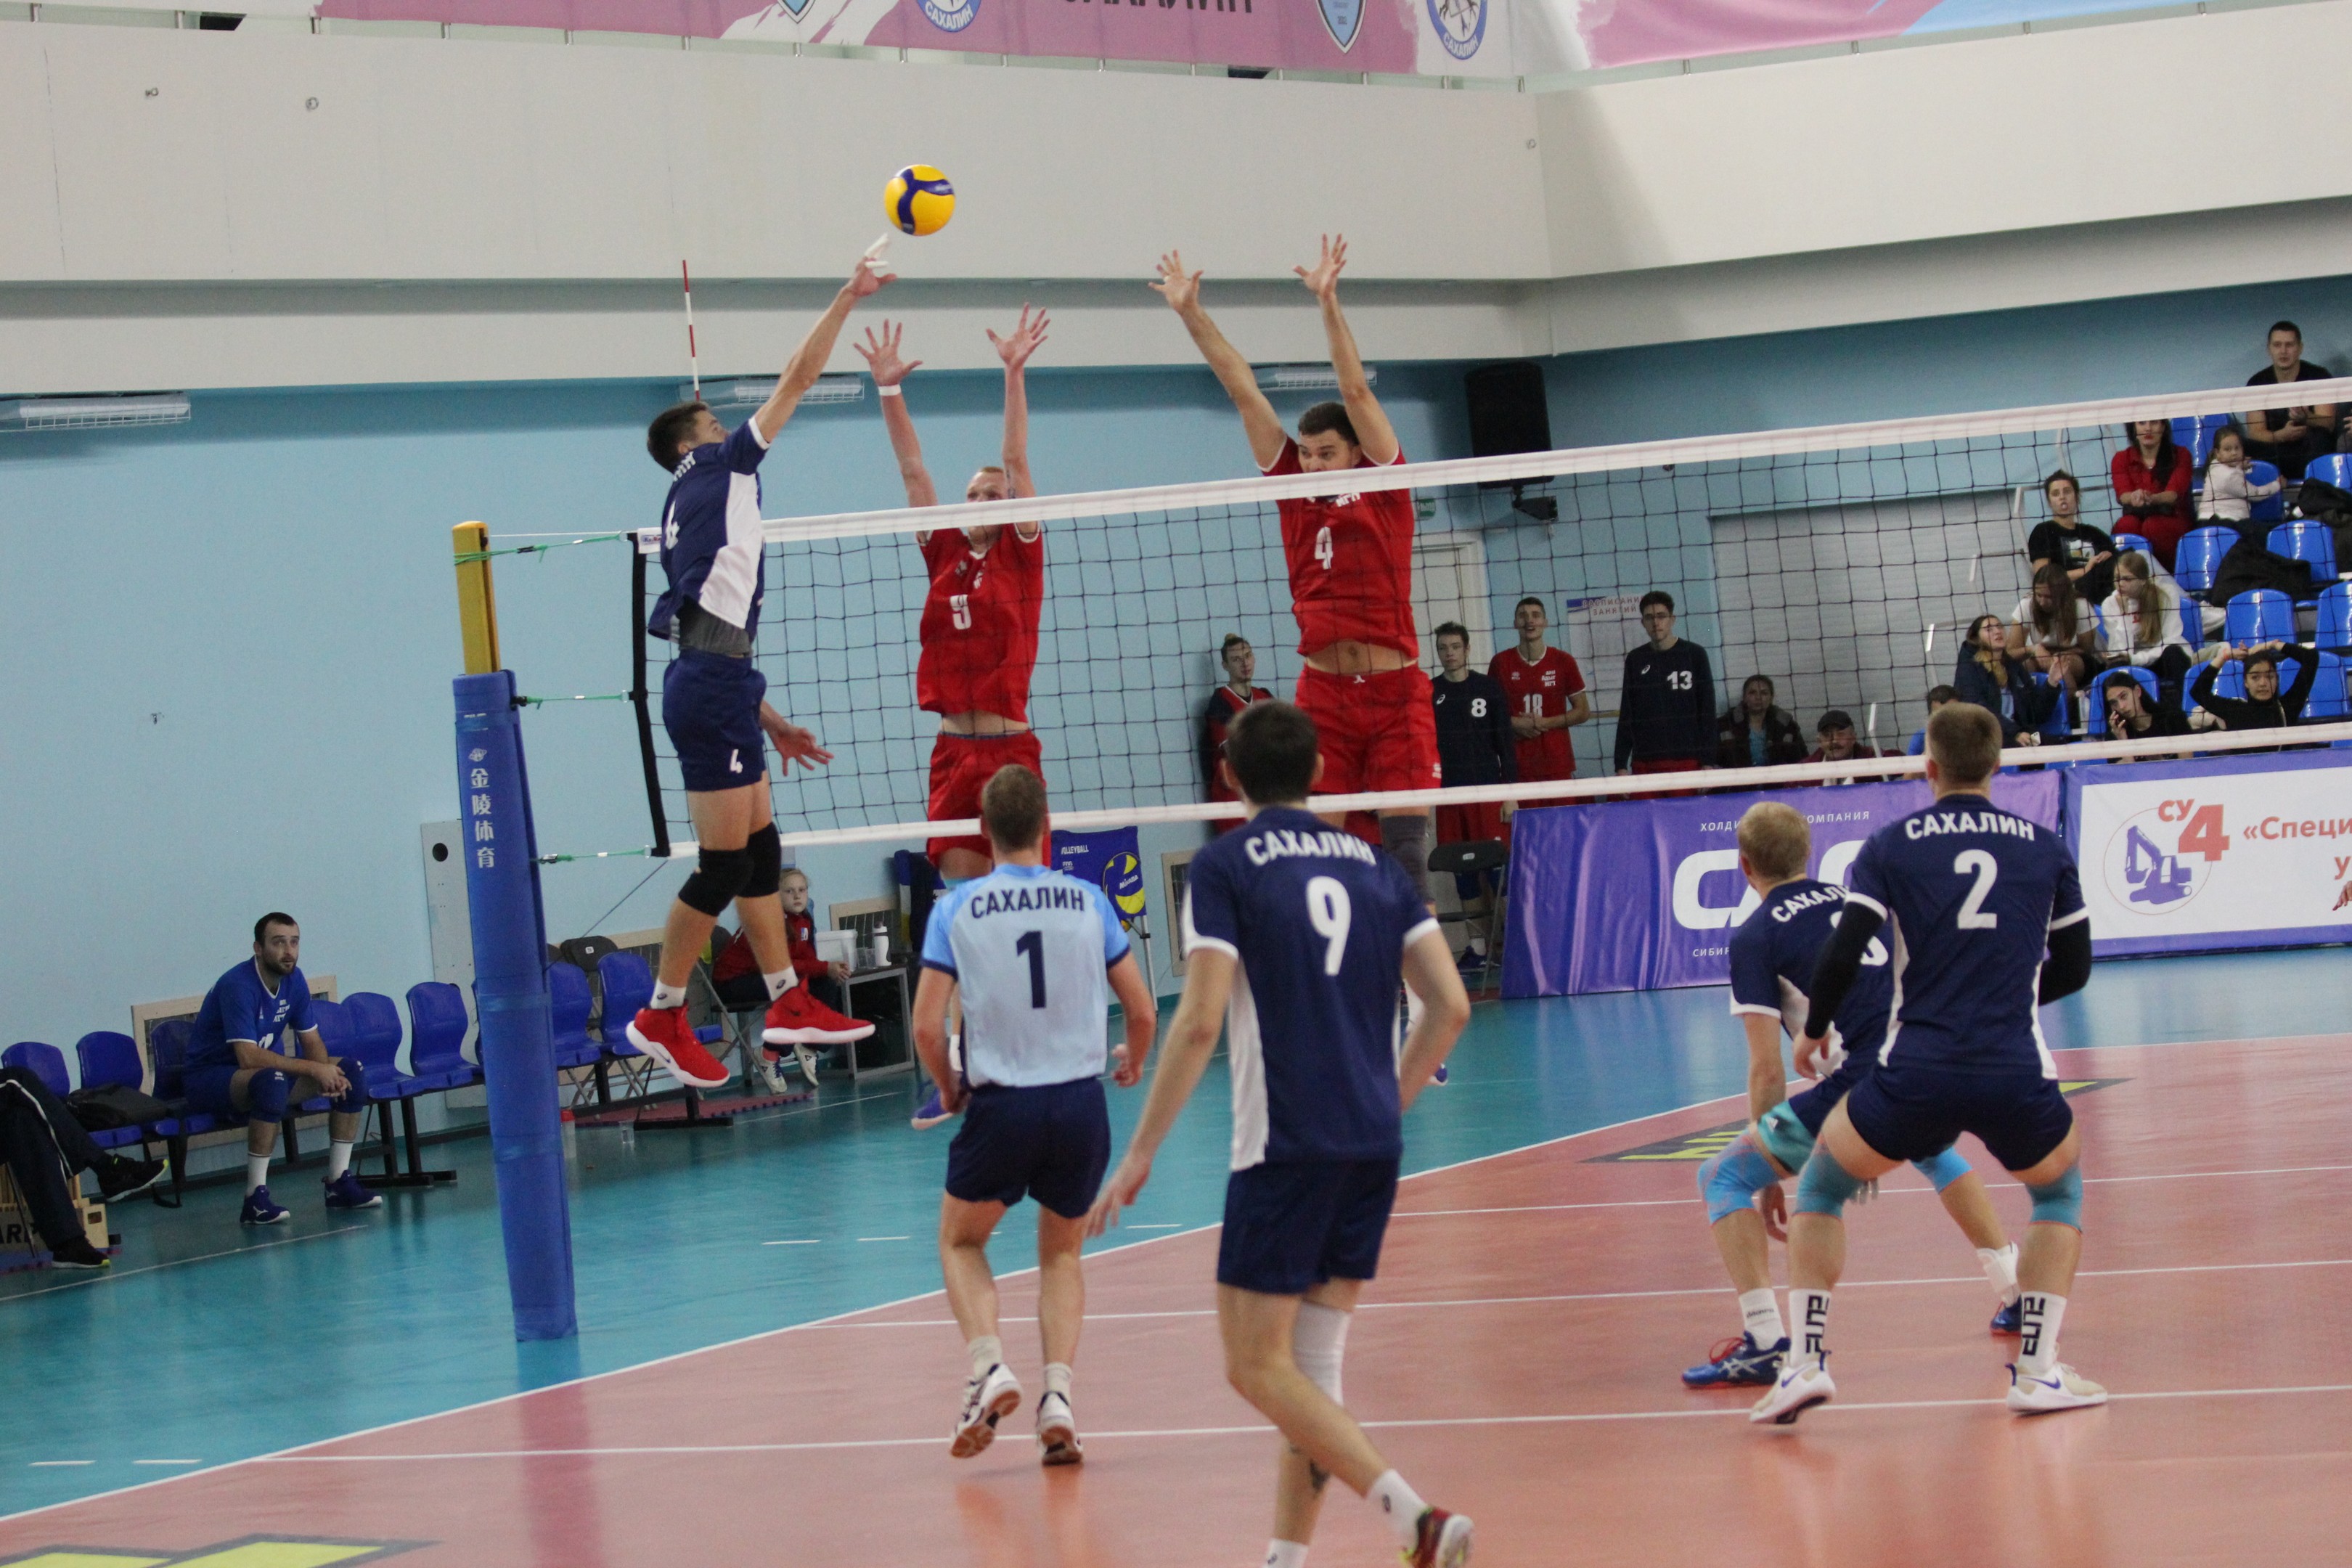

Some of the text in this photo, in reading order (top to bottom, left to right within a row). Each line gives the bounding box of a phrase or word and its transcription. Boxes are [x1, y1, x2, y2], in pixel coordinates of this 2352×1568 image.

[925, 4, 973, 30] САХАЛИН
[1443, 31, 1479, 57] САХАЛИН
[1315, 526, 1334, 570] 4
[1583, 597, 1643, 608] РАСПИСАНИ
[1593, 605, 1637, 616] ЗАНЯИЙ
[1667, 671, 1693, 689] 13
[1471, 698, 1487, 718] 8
[1523, 693, 1543, 716] 18
[730, 749, 743, 774] 4
[470, 768, 496, 868] 金陵体育
[1700, 811, 1870, 832] ХОЛДИ ОМПАНИЯ
[1905, 811, 2035, 841] САХАЛИН
[2157, 799, 2230, 862] СУ 4
[1244, 829, 1377, 866] САХАЛИН
[971, 886, 1085, 919] САХАЛИН
[1953, 849, 1997, 929] 2
[1771, 884, 1850, 923] САХАЛ
[1307, 875, 1352, 976] 9
[1693, 947, 1730, 957] СИБИР
[1016, 930, 1047, 1009] 1
